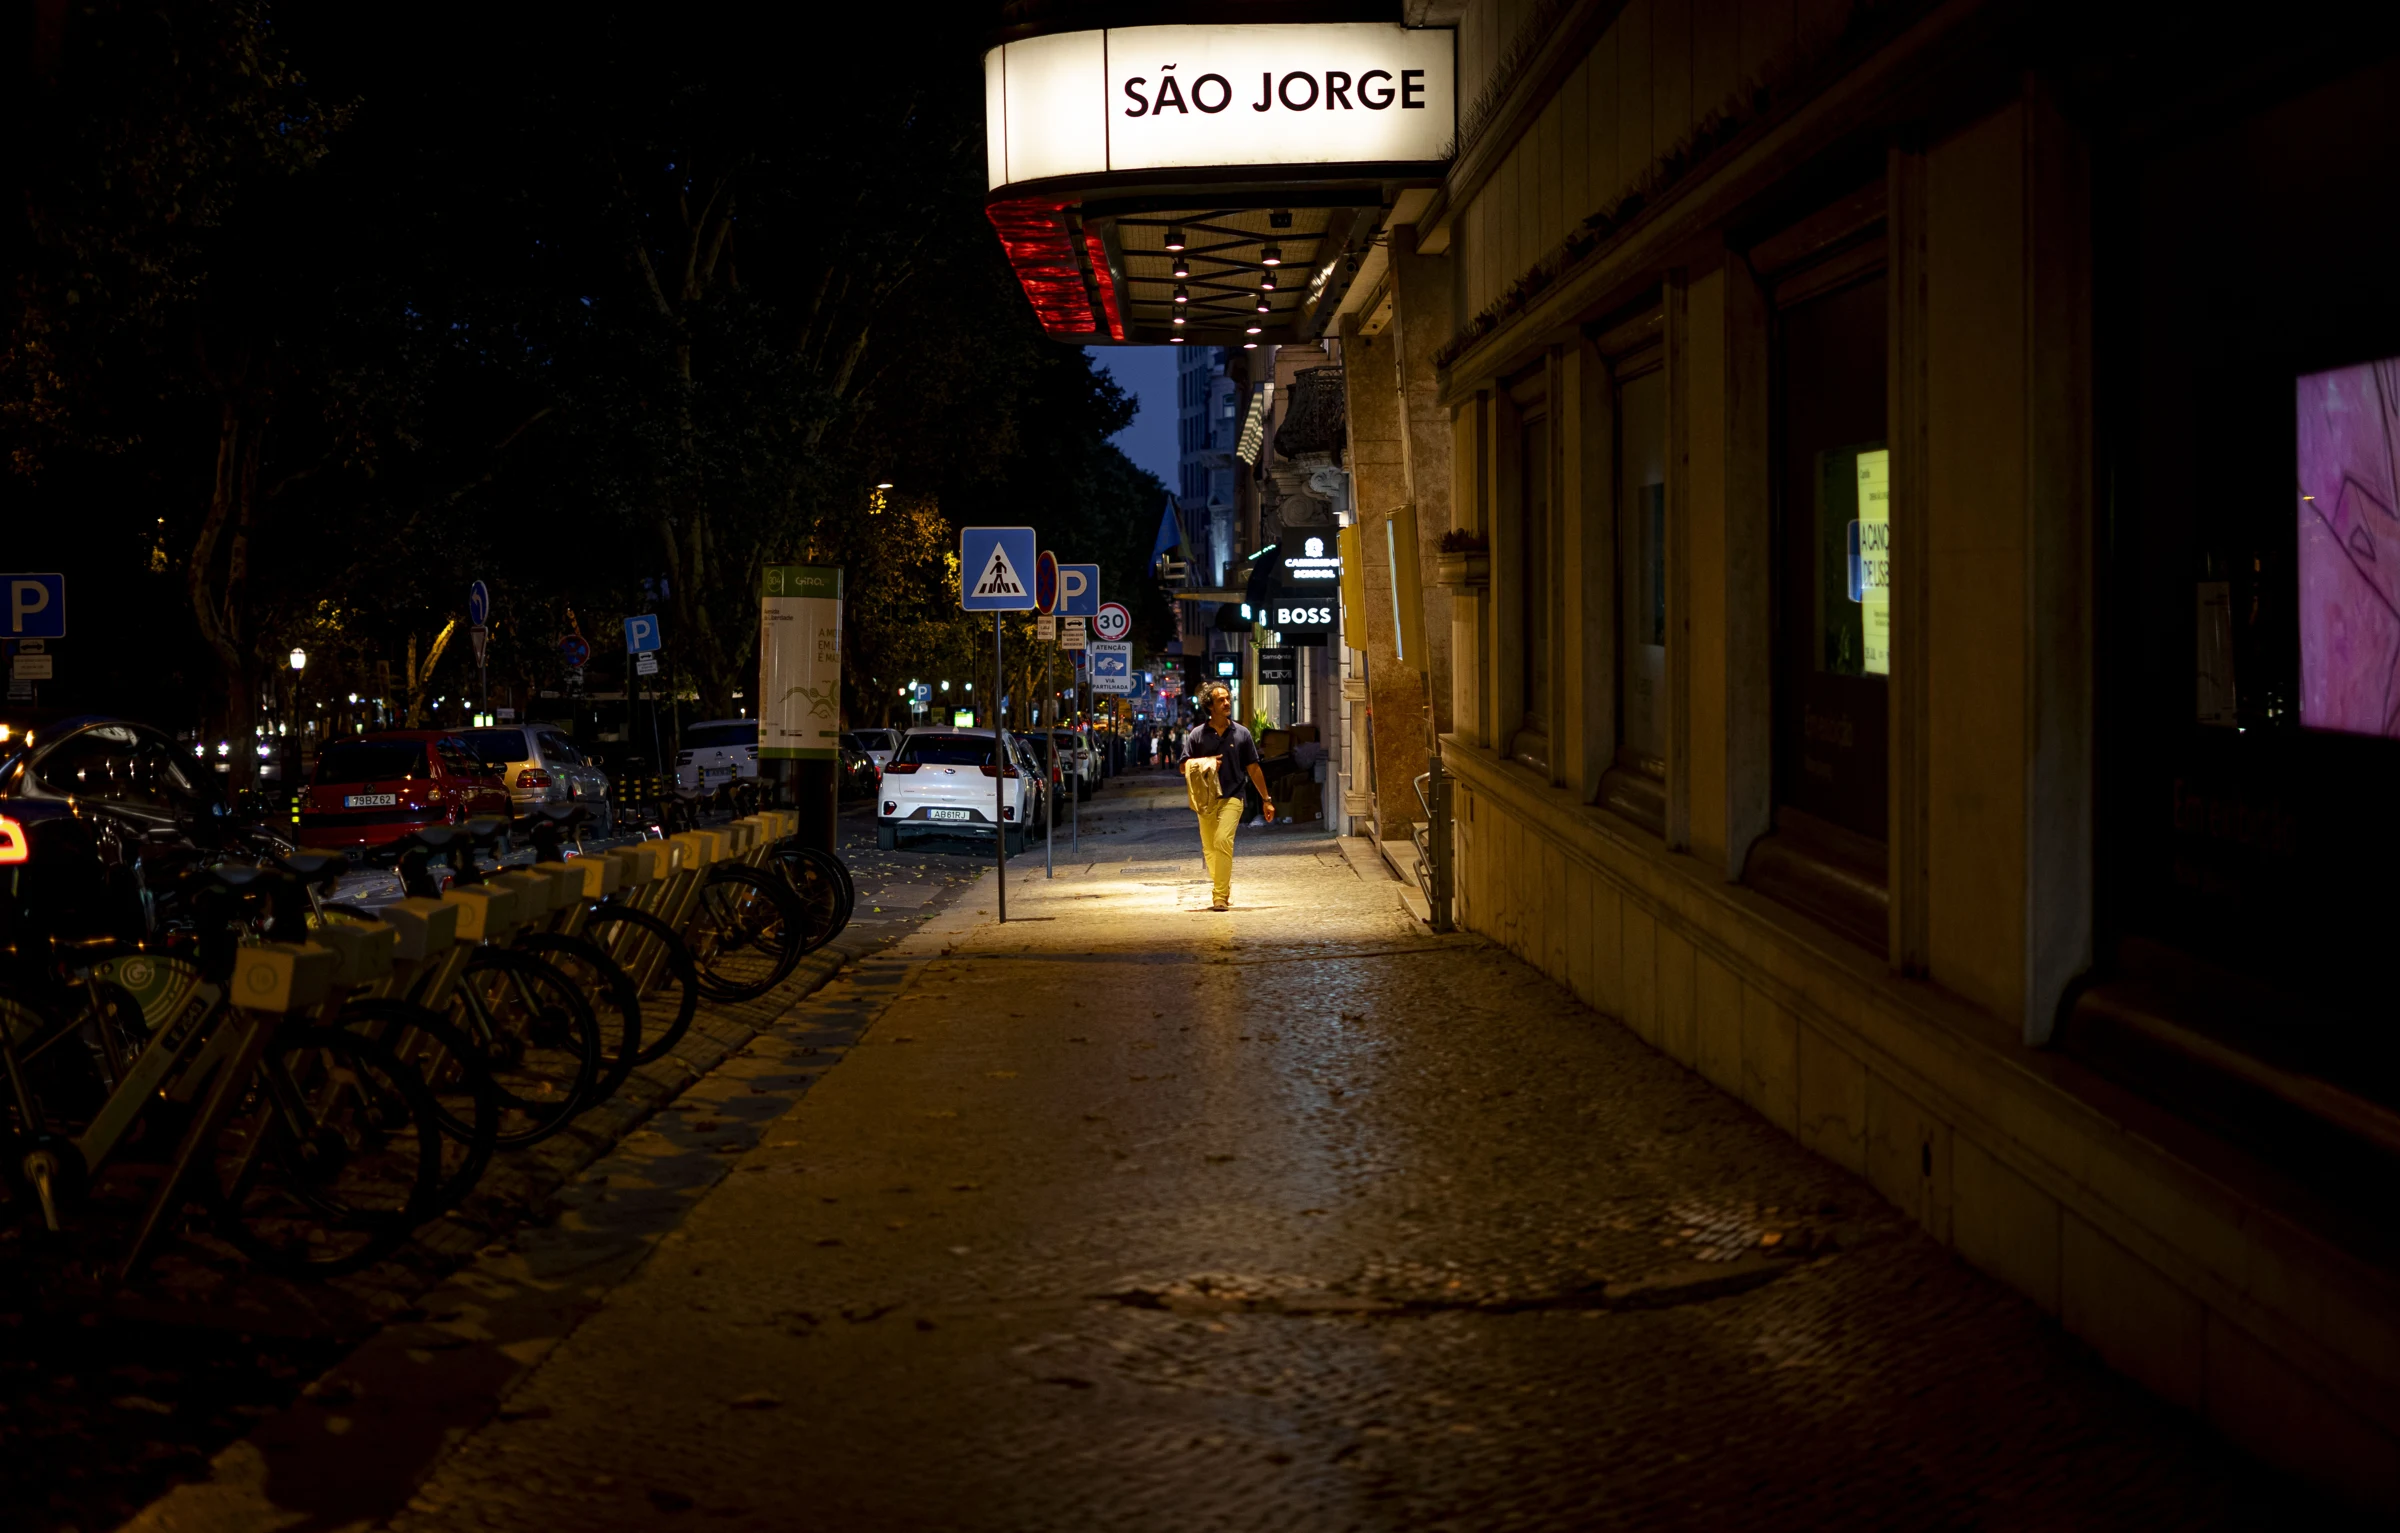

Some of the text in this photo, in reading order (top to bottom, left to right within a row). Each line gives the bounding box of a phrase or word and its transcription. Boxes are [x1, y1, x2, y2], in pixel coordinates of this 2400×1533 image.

[1124, 63, 1426, 118] SÃO JORGE
[1059, 570, 1088, 612] P
[11, 580, 50, 633] P
[1099, 614, 1124, 629] 30
[1278, 607, 1332, 624] BOSS
[631, 619, 650, 649] P
[1096, 644, 1127, 652] ATENÇÃO
[1262, 670, 1293, 679] TUMI
[917, 686, 928, 700] P
[934, 810, 966, 819] AB61RJ
